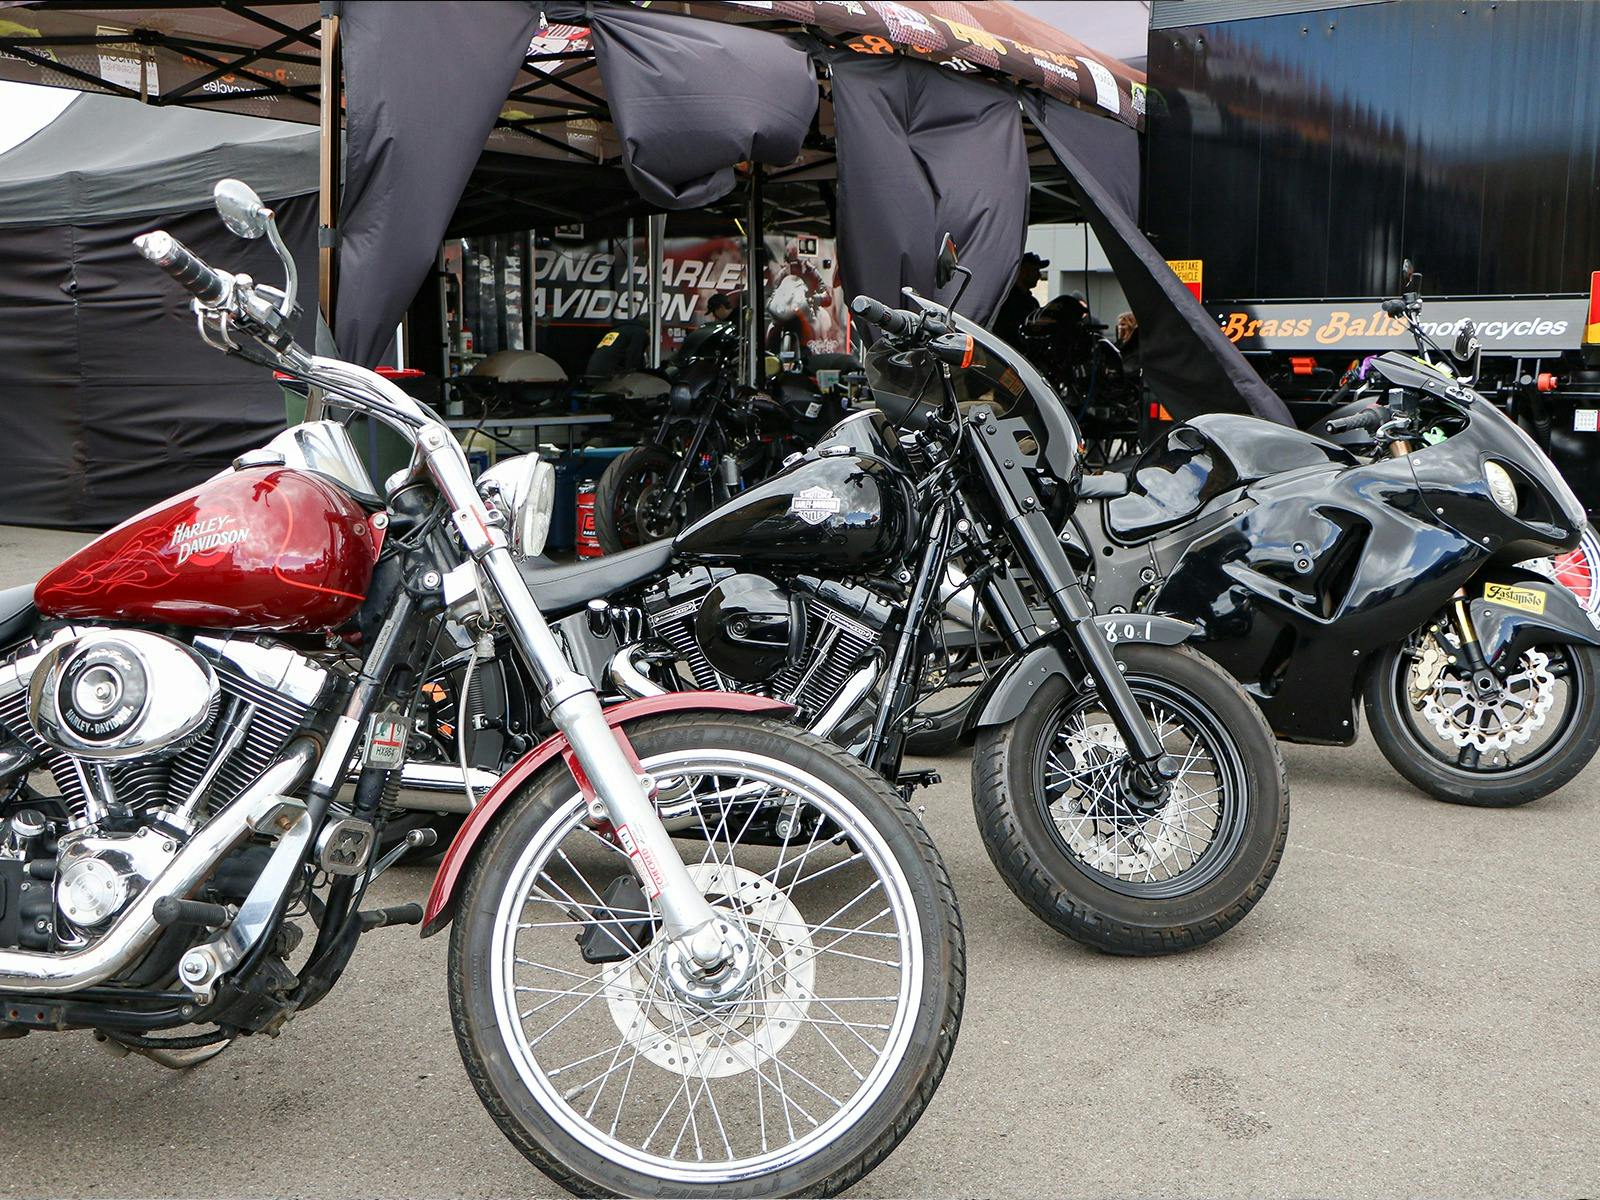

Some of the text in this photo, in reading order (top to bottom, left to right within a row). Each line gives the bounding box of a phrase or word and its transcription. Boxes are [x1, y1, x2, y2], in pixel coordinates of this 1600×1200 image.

[534, 287, 699, 321] AVIDSON
[1221, 312, 1312, 343] Brass
[1315, 311, 1410, 344] Balls
[174, 527, 249, 568] DAVIDSON
[655, 1177, 782, 1199] PIRELLI
